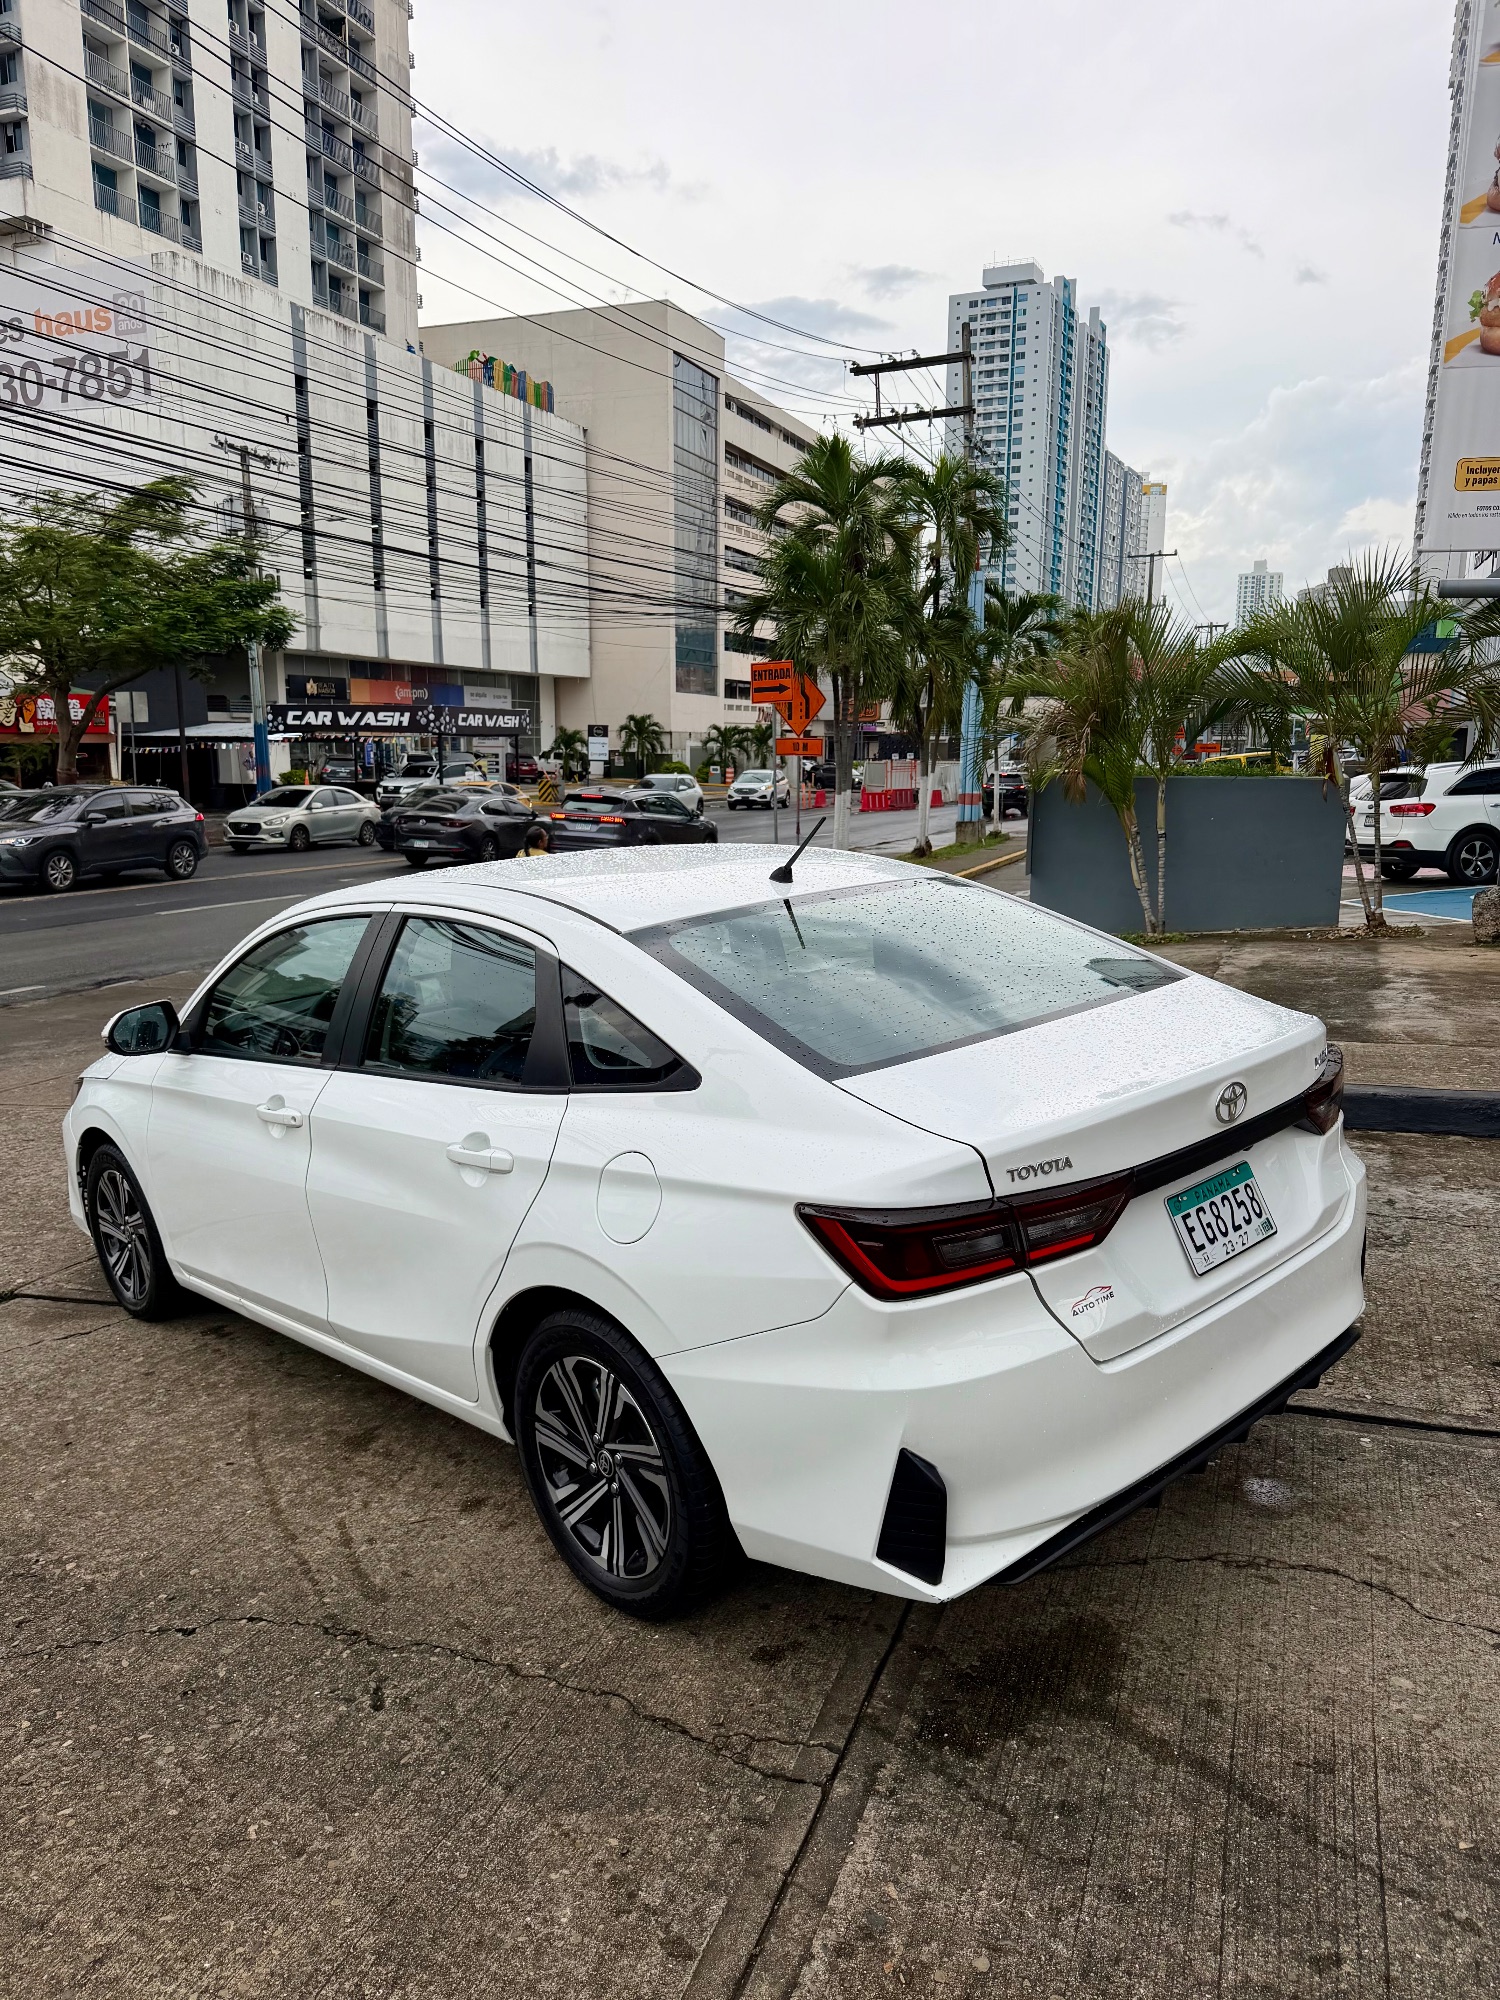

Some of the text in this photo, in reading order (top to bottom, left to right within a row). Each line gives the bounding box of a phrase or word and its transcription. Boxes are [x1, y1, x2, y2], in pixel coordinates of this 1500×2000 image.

[34, 307, 113, 337] haus
[1464, 477, 1498, 487] y papas
[753, 667, 791, 681] ENTRADA
[286, 711, 411, 727] CAR WASH
[457, 713, 520, 728] CAR WASH
[1006, 1155, 1073, 1182] TOYOTA
[1181, 1182, 1263, 1253] EG8258
[1072, 1290, 1115, 1317] AUTO TIME
